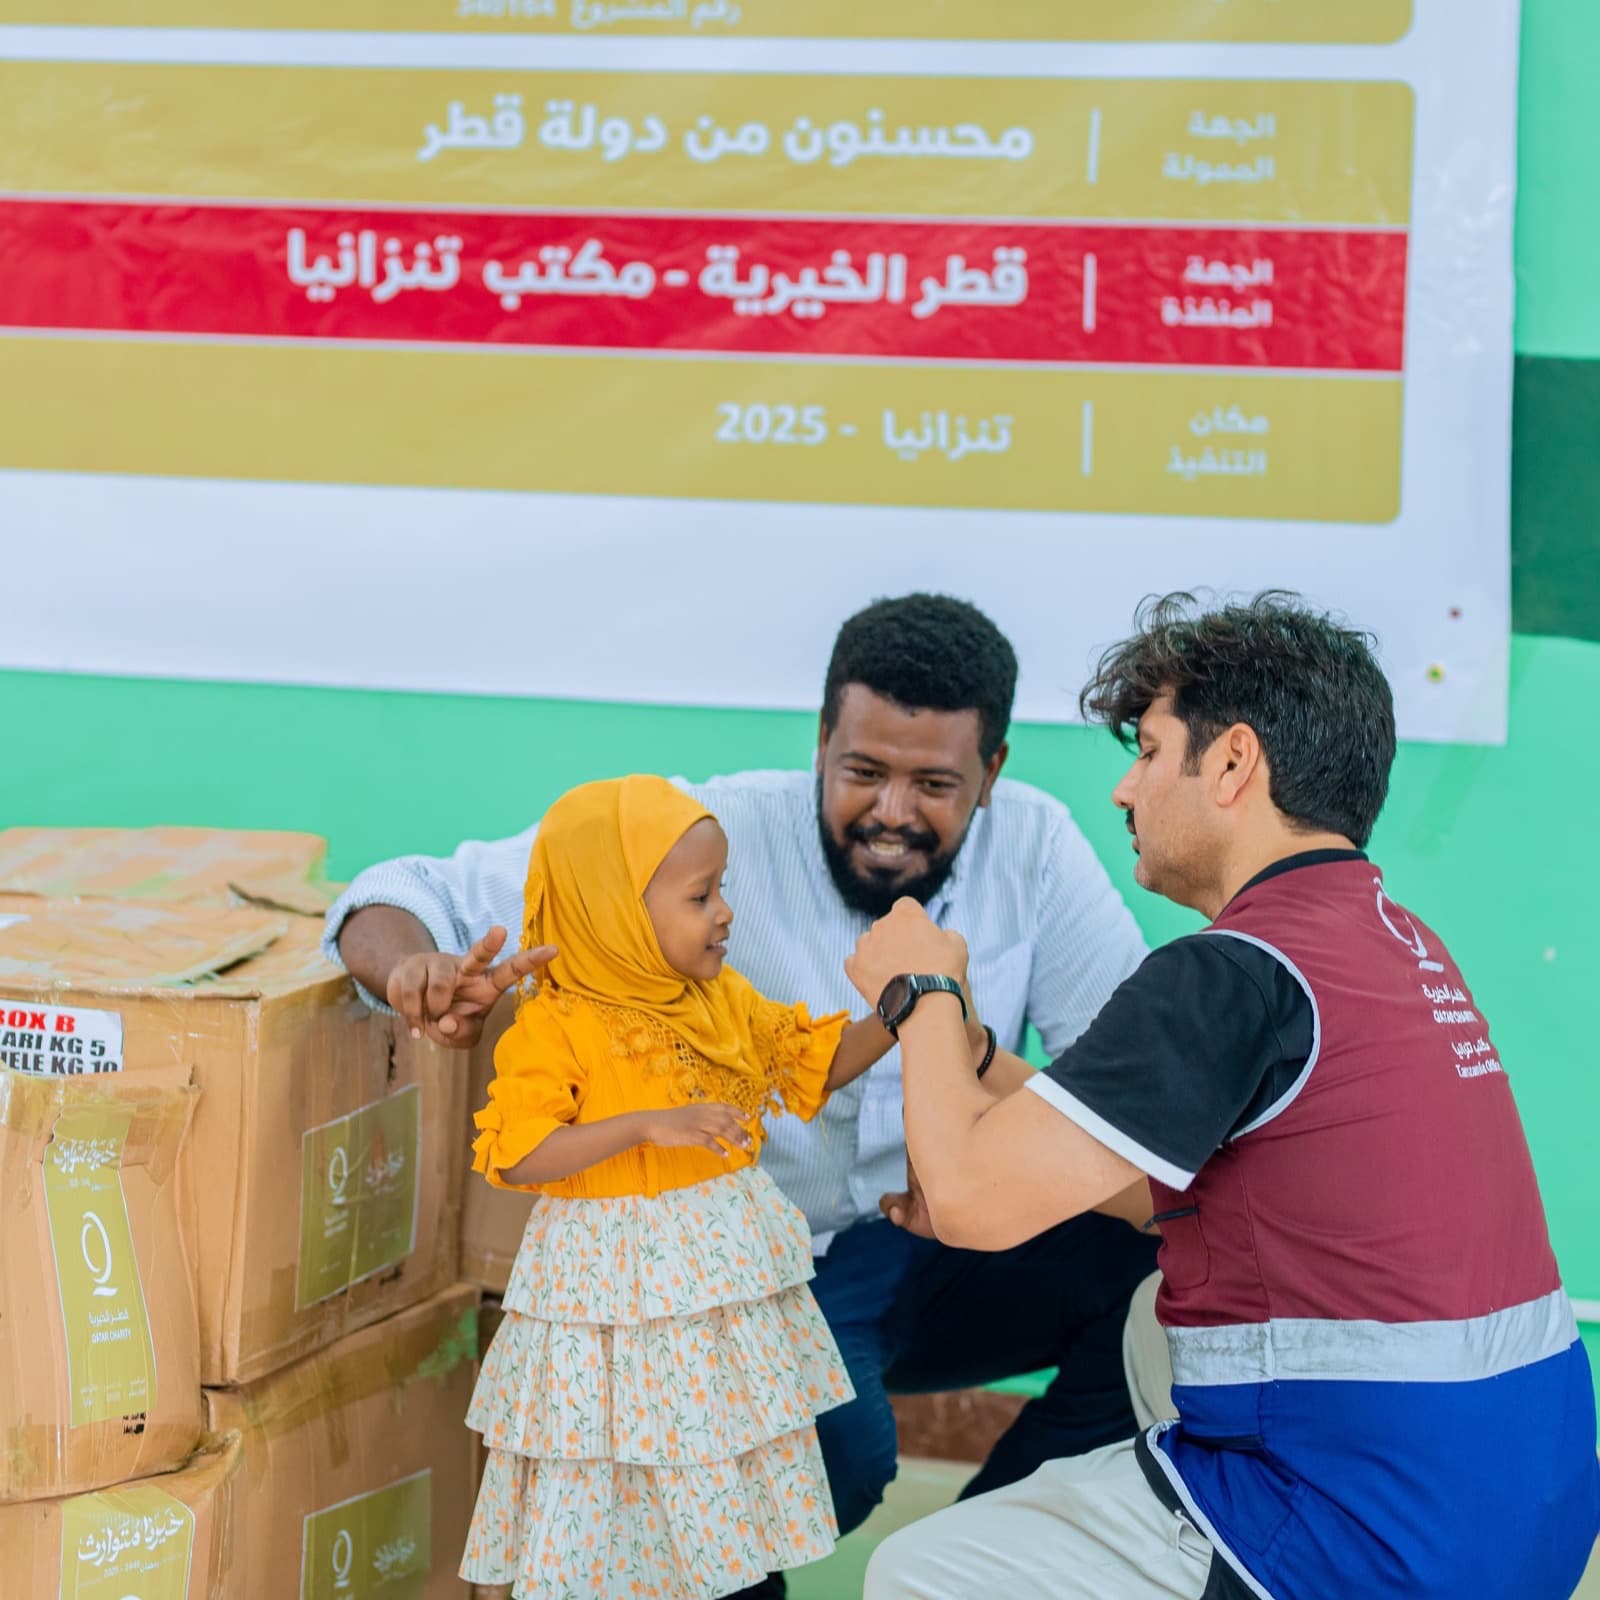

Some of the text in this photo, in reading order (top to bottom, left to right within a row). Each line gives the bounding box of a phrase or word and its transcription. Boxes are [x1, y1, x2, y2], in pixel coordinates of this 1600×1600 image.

[416, 93, 1035, 167] محسنون من دولة قطر
[287, 229, 462, 302] تنزانيا
[482, 239, 656, 311] مكتب
[699, 245, 908, 319] الخيرية
[911, 247, 1028, 318] قطر
[714, 402, 828, 445] 2025
[882, 409, 1013, 461] تنزانيا
[0, 1009, 76, 1034] OX B
[50, 1035, 83, 1055] KG
[90, 1039, 106, 1057] 5
[51, 1056, 84, 1075] KG
[91, 1061, 118, 1073] 10
